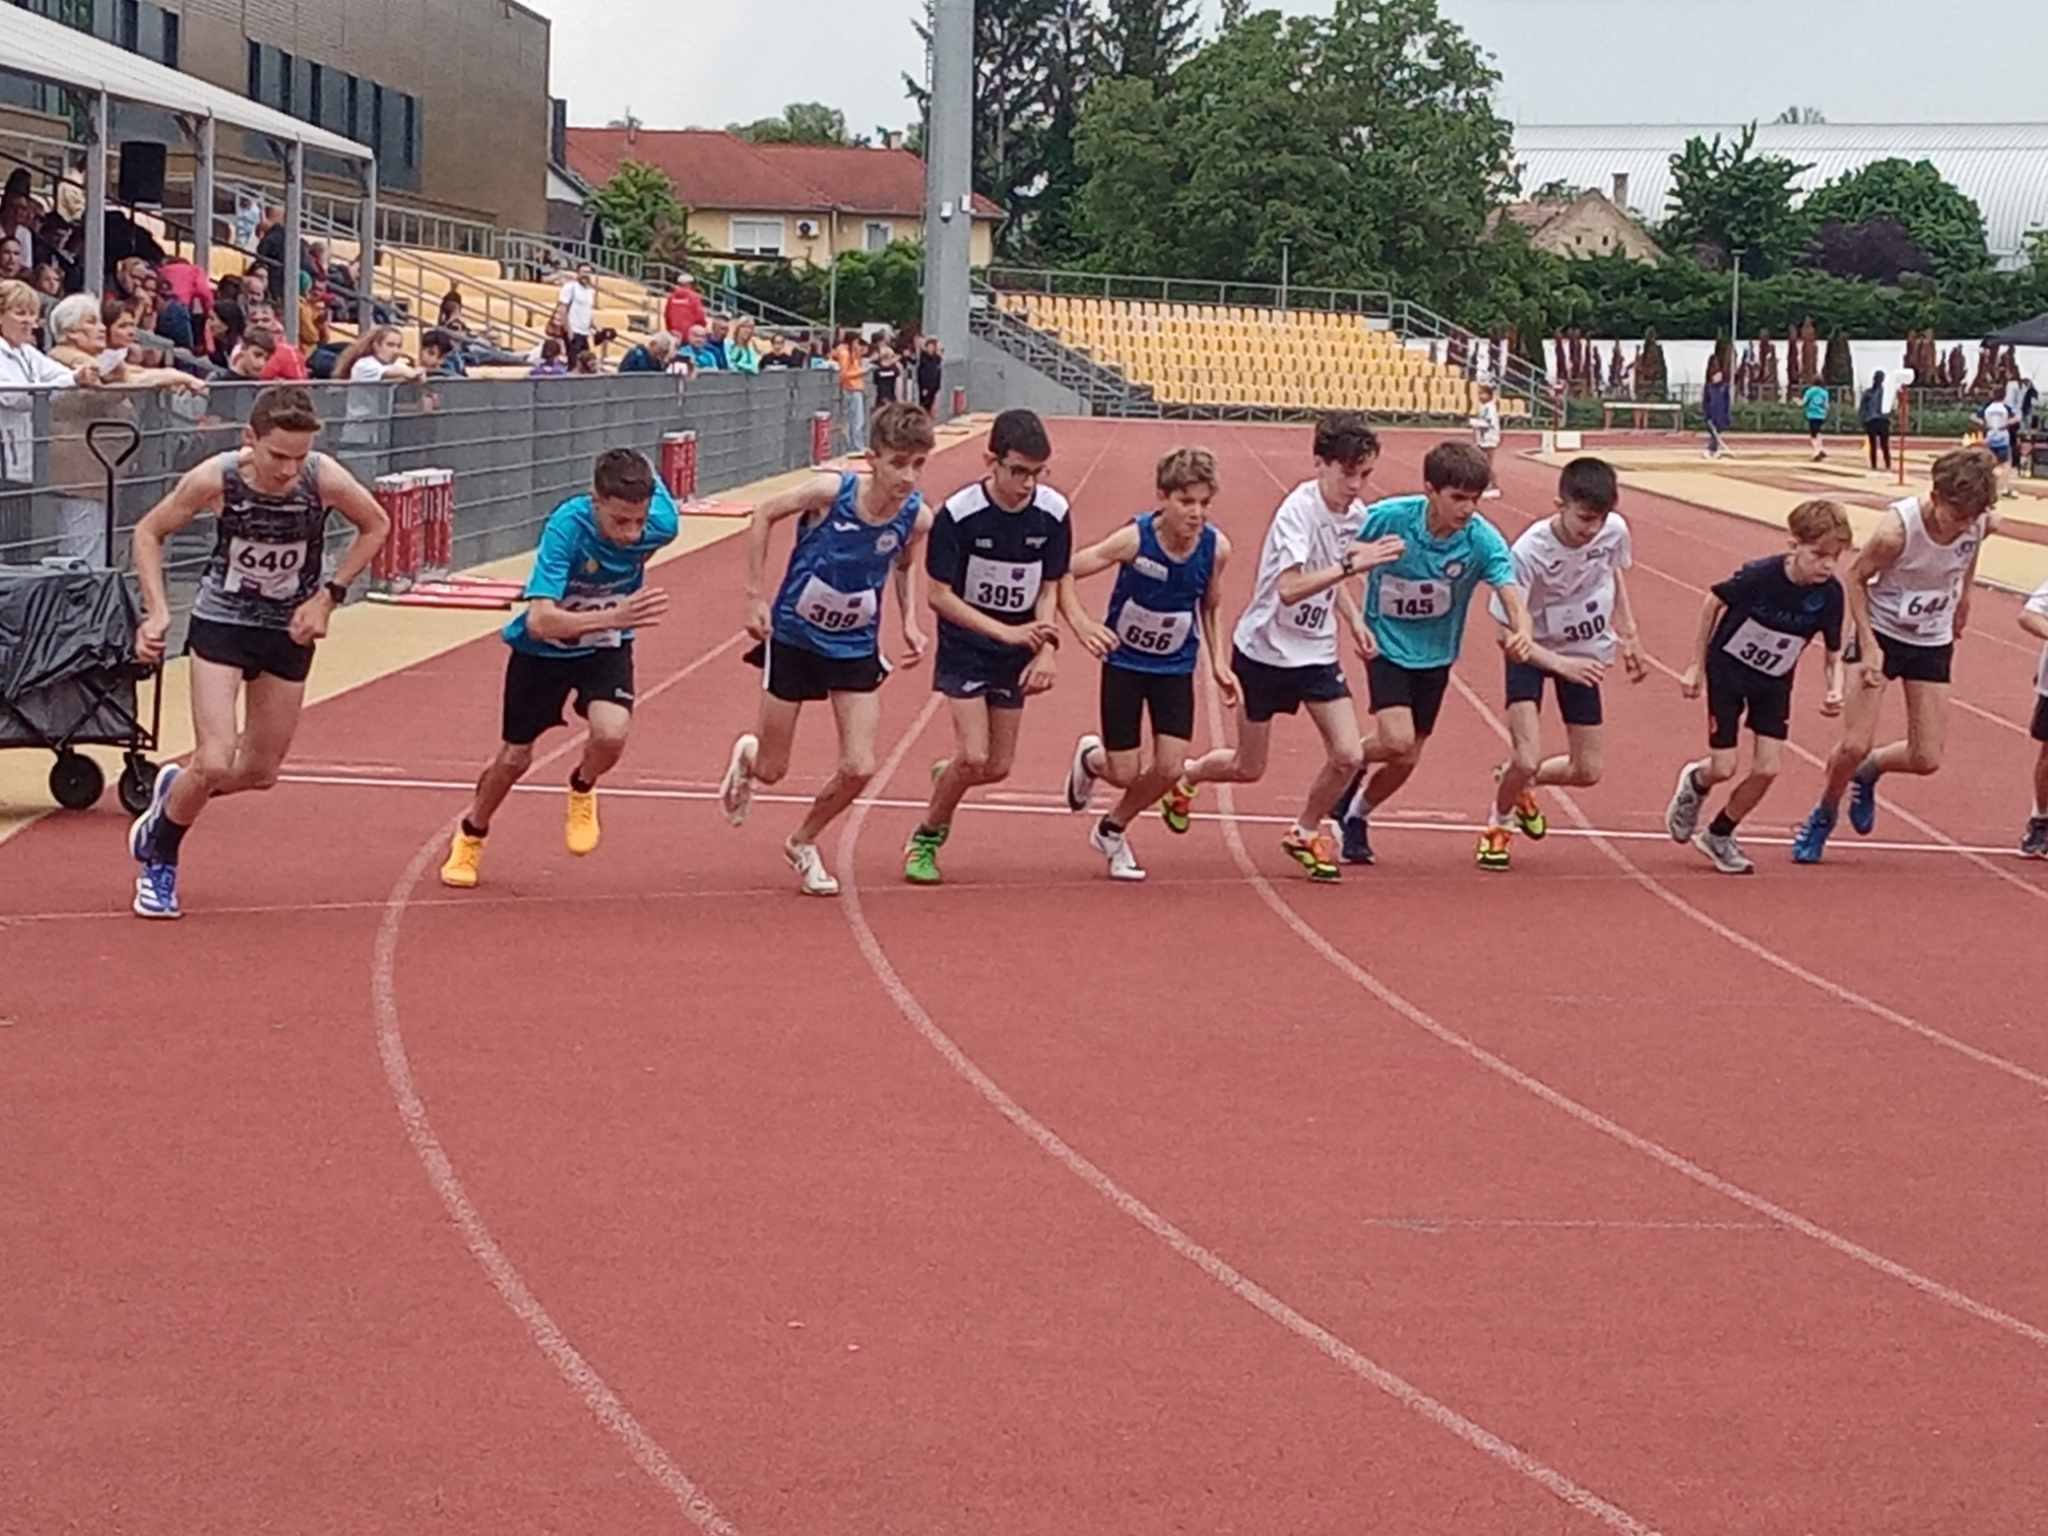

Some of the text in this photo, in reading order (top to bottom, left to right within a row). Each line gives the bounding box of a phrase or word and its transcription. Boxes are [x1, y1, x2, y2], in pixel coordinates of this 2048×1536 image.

[238, 545, 298, 573] 640
[977, 581, 1025, 609] 395
[1392, 598, 1434, 615] 145
[1740, 641, 1783, 671] 397
